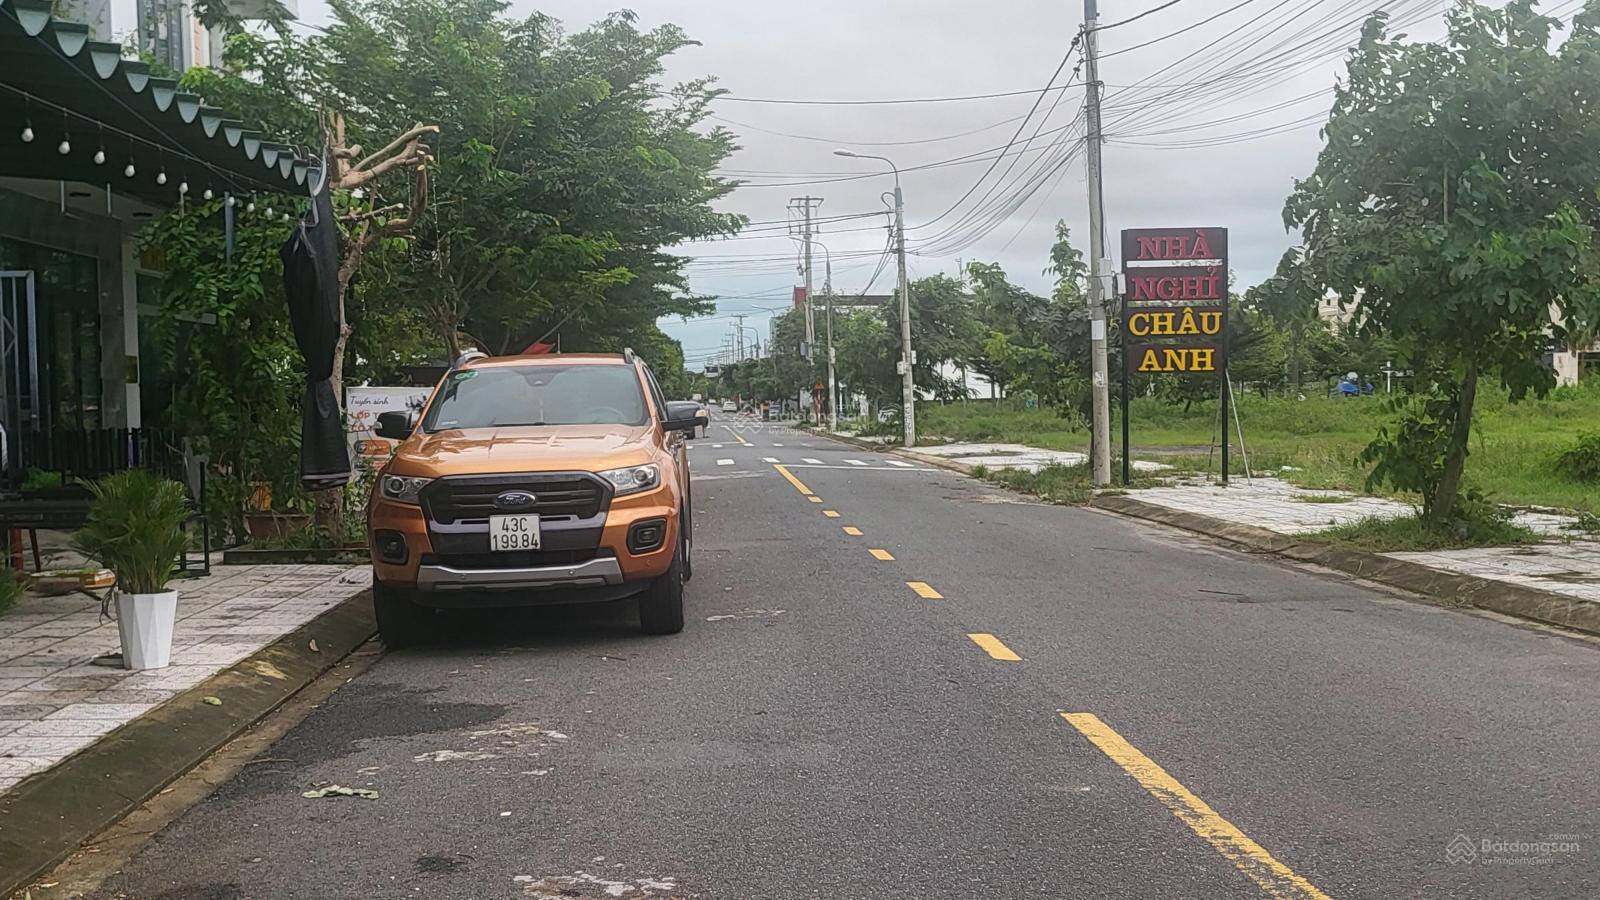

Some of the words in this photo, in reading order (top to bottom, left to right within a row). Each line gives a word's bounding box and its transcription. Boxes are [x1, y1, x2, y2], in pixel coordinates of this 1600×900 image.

[1136, 229, 1214, 260] NHÀ
[1131, 265, 1220, 300] NGHỈ
[1128, 306, 1223, 336] CHÂU
[1138, 348, 1215, 372] ANH
[502, 517, 528, 533] 43C
[492, 533, 539, 549] 199.84
